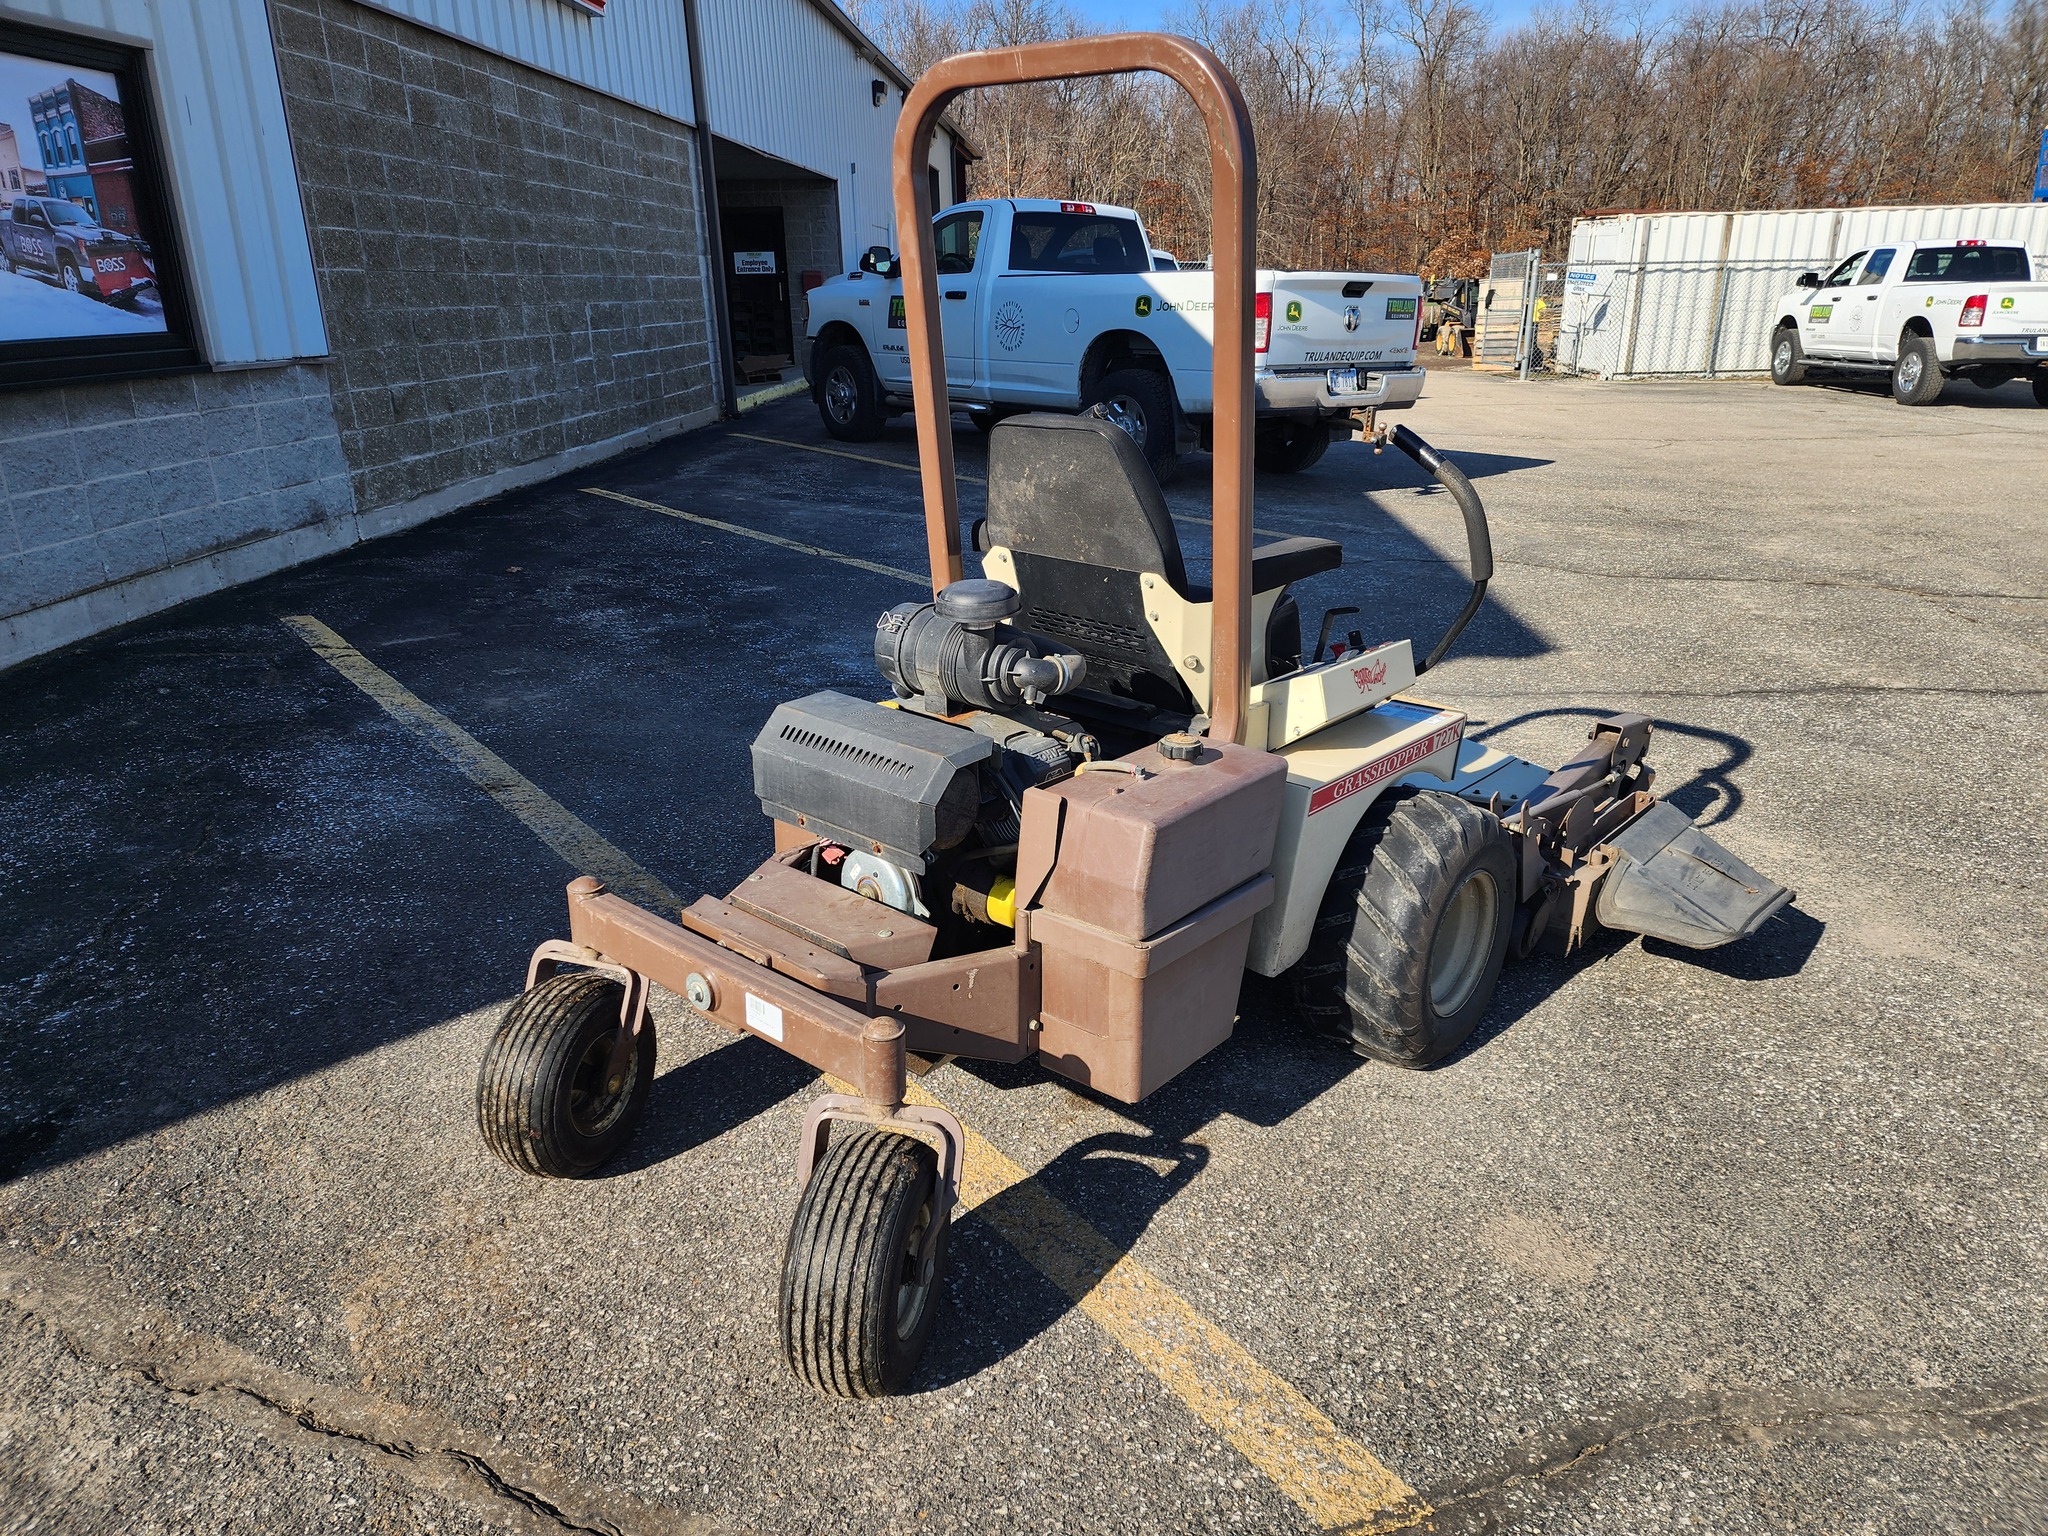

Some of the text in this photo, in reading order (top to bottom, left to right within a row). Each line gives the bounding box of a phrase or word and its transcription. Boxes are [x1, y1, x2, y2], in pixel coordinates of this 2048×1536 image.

[20, 236, 44, 257] BOSS
[96, 257, 126, 272] BOSS
[1156, 300, 1214, 311] JOHN DEER
[1388, 300, 1415, 312] TRULAND
[1304, 351, 1382, 361] TRULANDEQUIP.COM
[1334, 721, 1461, 799] GRASSHOPPER 727K
